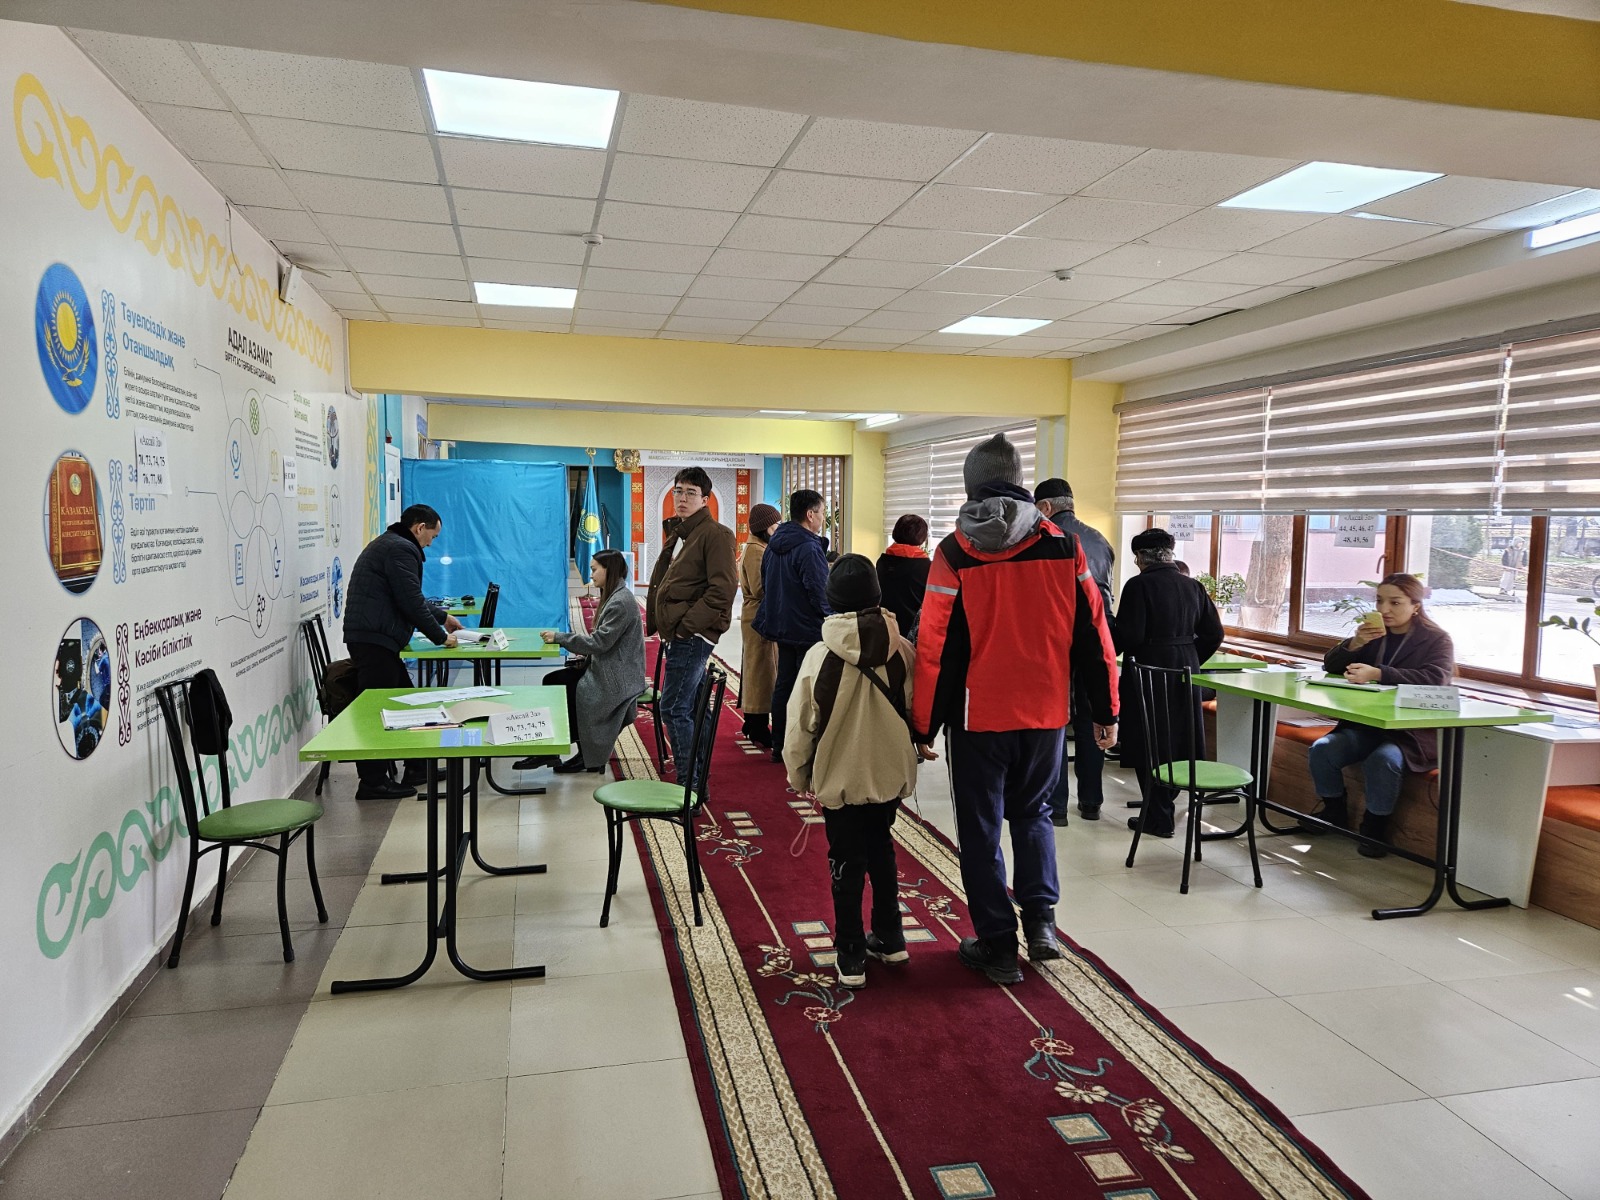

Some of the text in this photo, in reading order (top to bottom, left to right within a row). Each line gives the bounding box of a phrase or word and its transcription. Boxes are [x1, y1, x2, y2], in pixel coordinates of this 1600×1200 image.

[121, 301, 185, 348] Тәуелсіздік және
[123, 331, 174, 371] Отаншылдық
[228, 327, 272, 369] АДАЛ АЗАМАТ
[129, 493, 155, 514] Тәртіп
[134, 609, 201, 640] Еңбекқорлық және
[135, 644, 161, 668] Кәсіби
[162, 632, 192, 657] біліктілік
[525, 732, 534, 740] 77,
